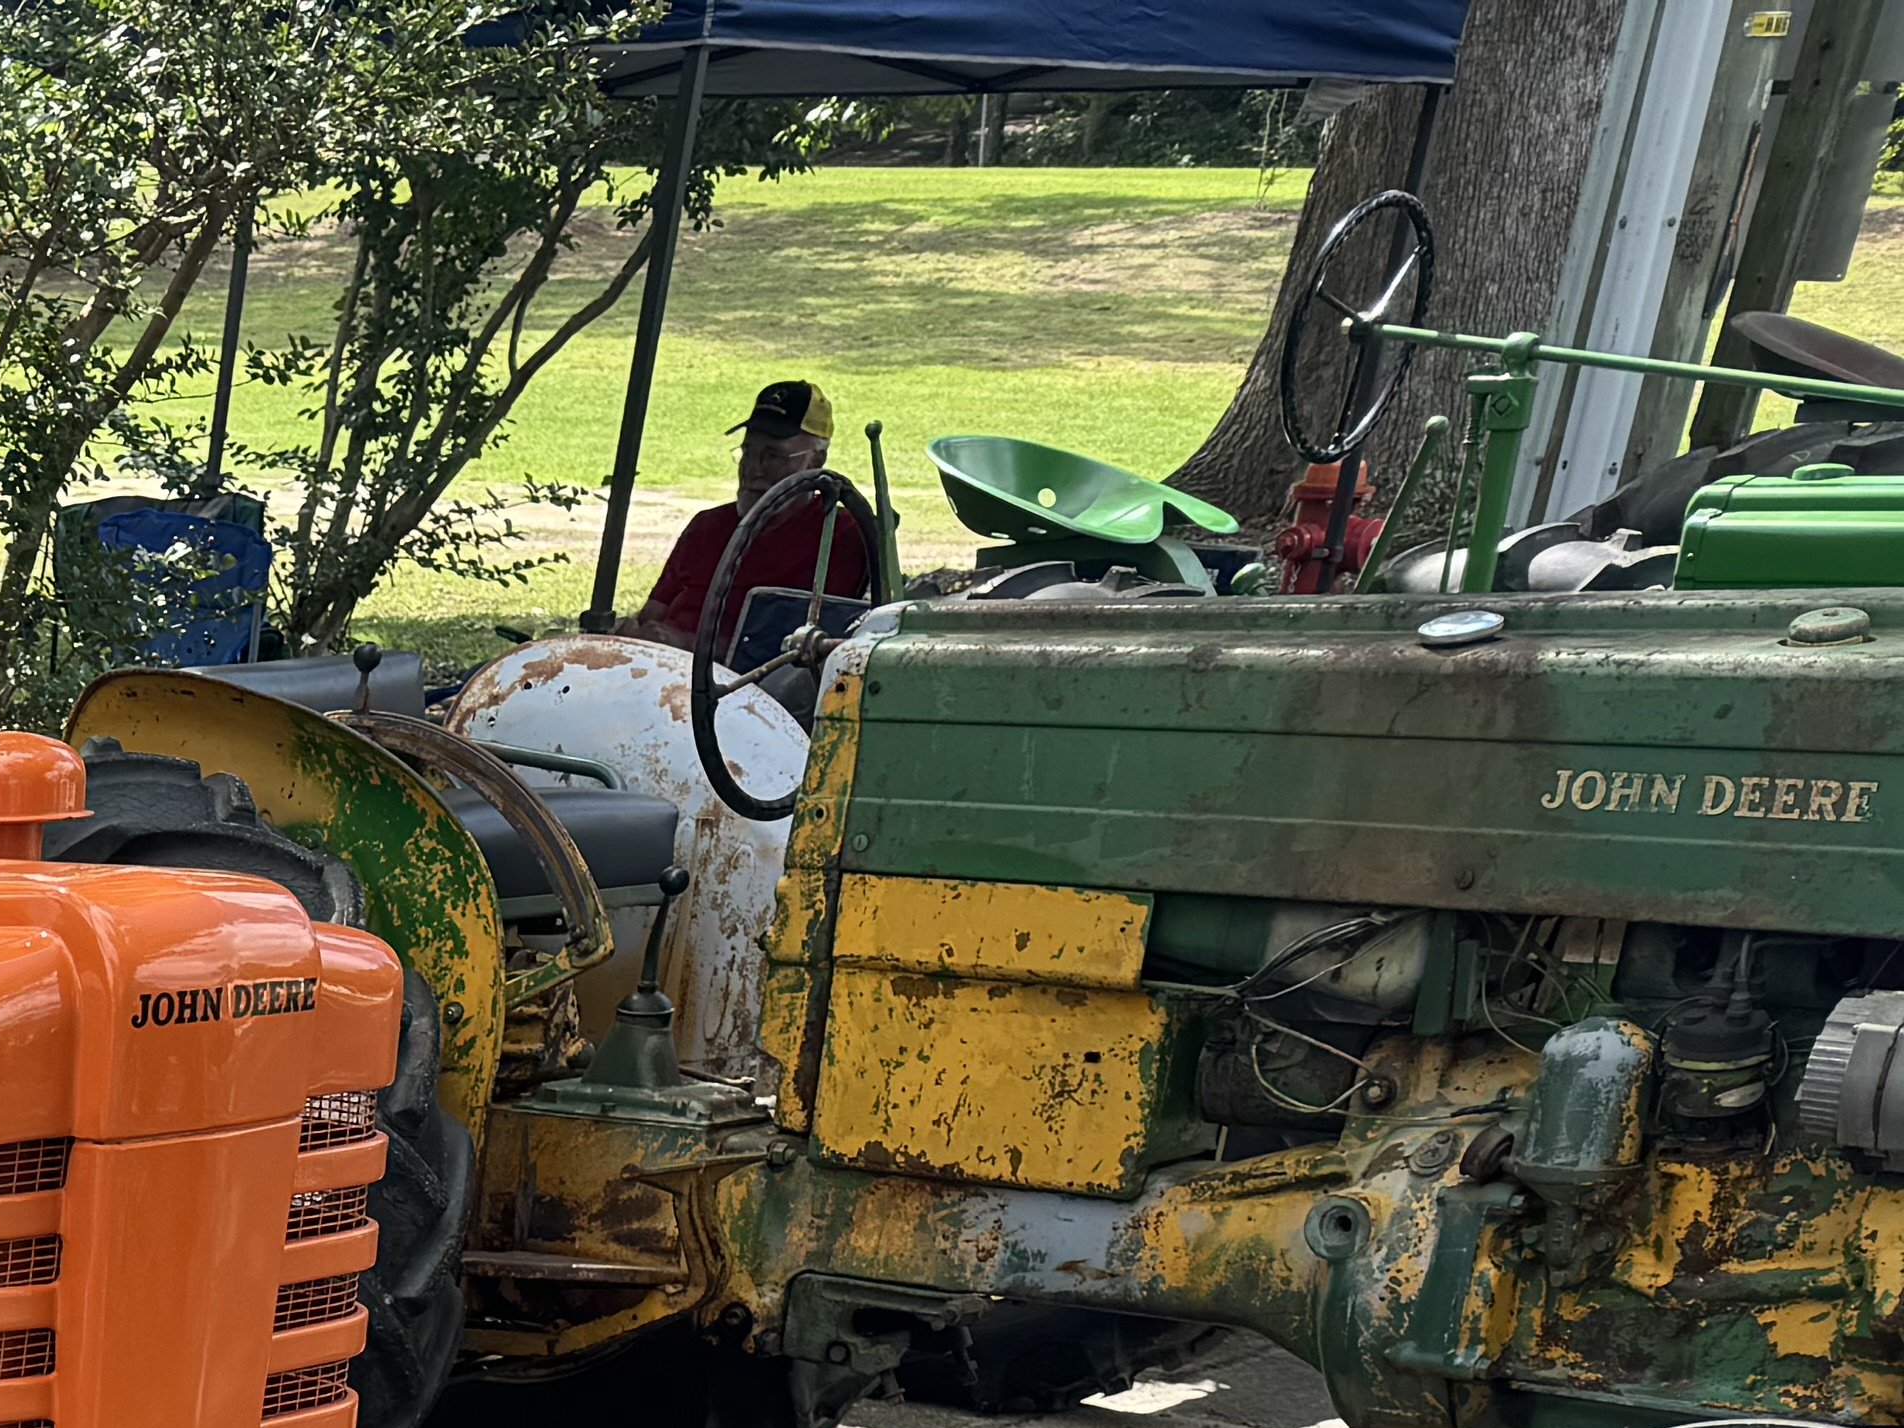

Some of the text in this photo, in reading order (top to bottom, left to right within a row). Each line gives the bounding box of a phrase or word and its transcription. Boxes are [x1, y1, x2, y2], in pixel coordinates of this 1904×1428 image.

[1540, 769, 1879, 822] JOHN DEERE
[131, 977, 318, 1029] JOHN DEERE
